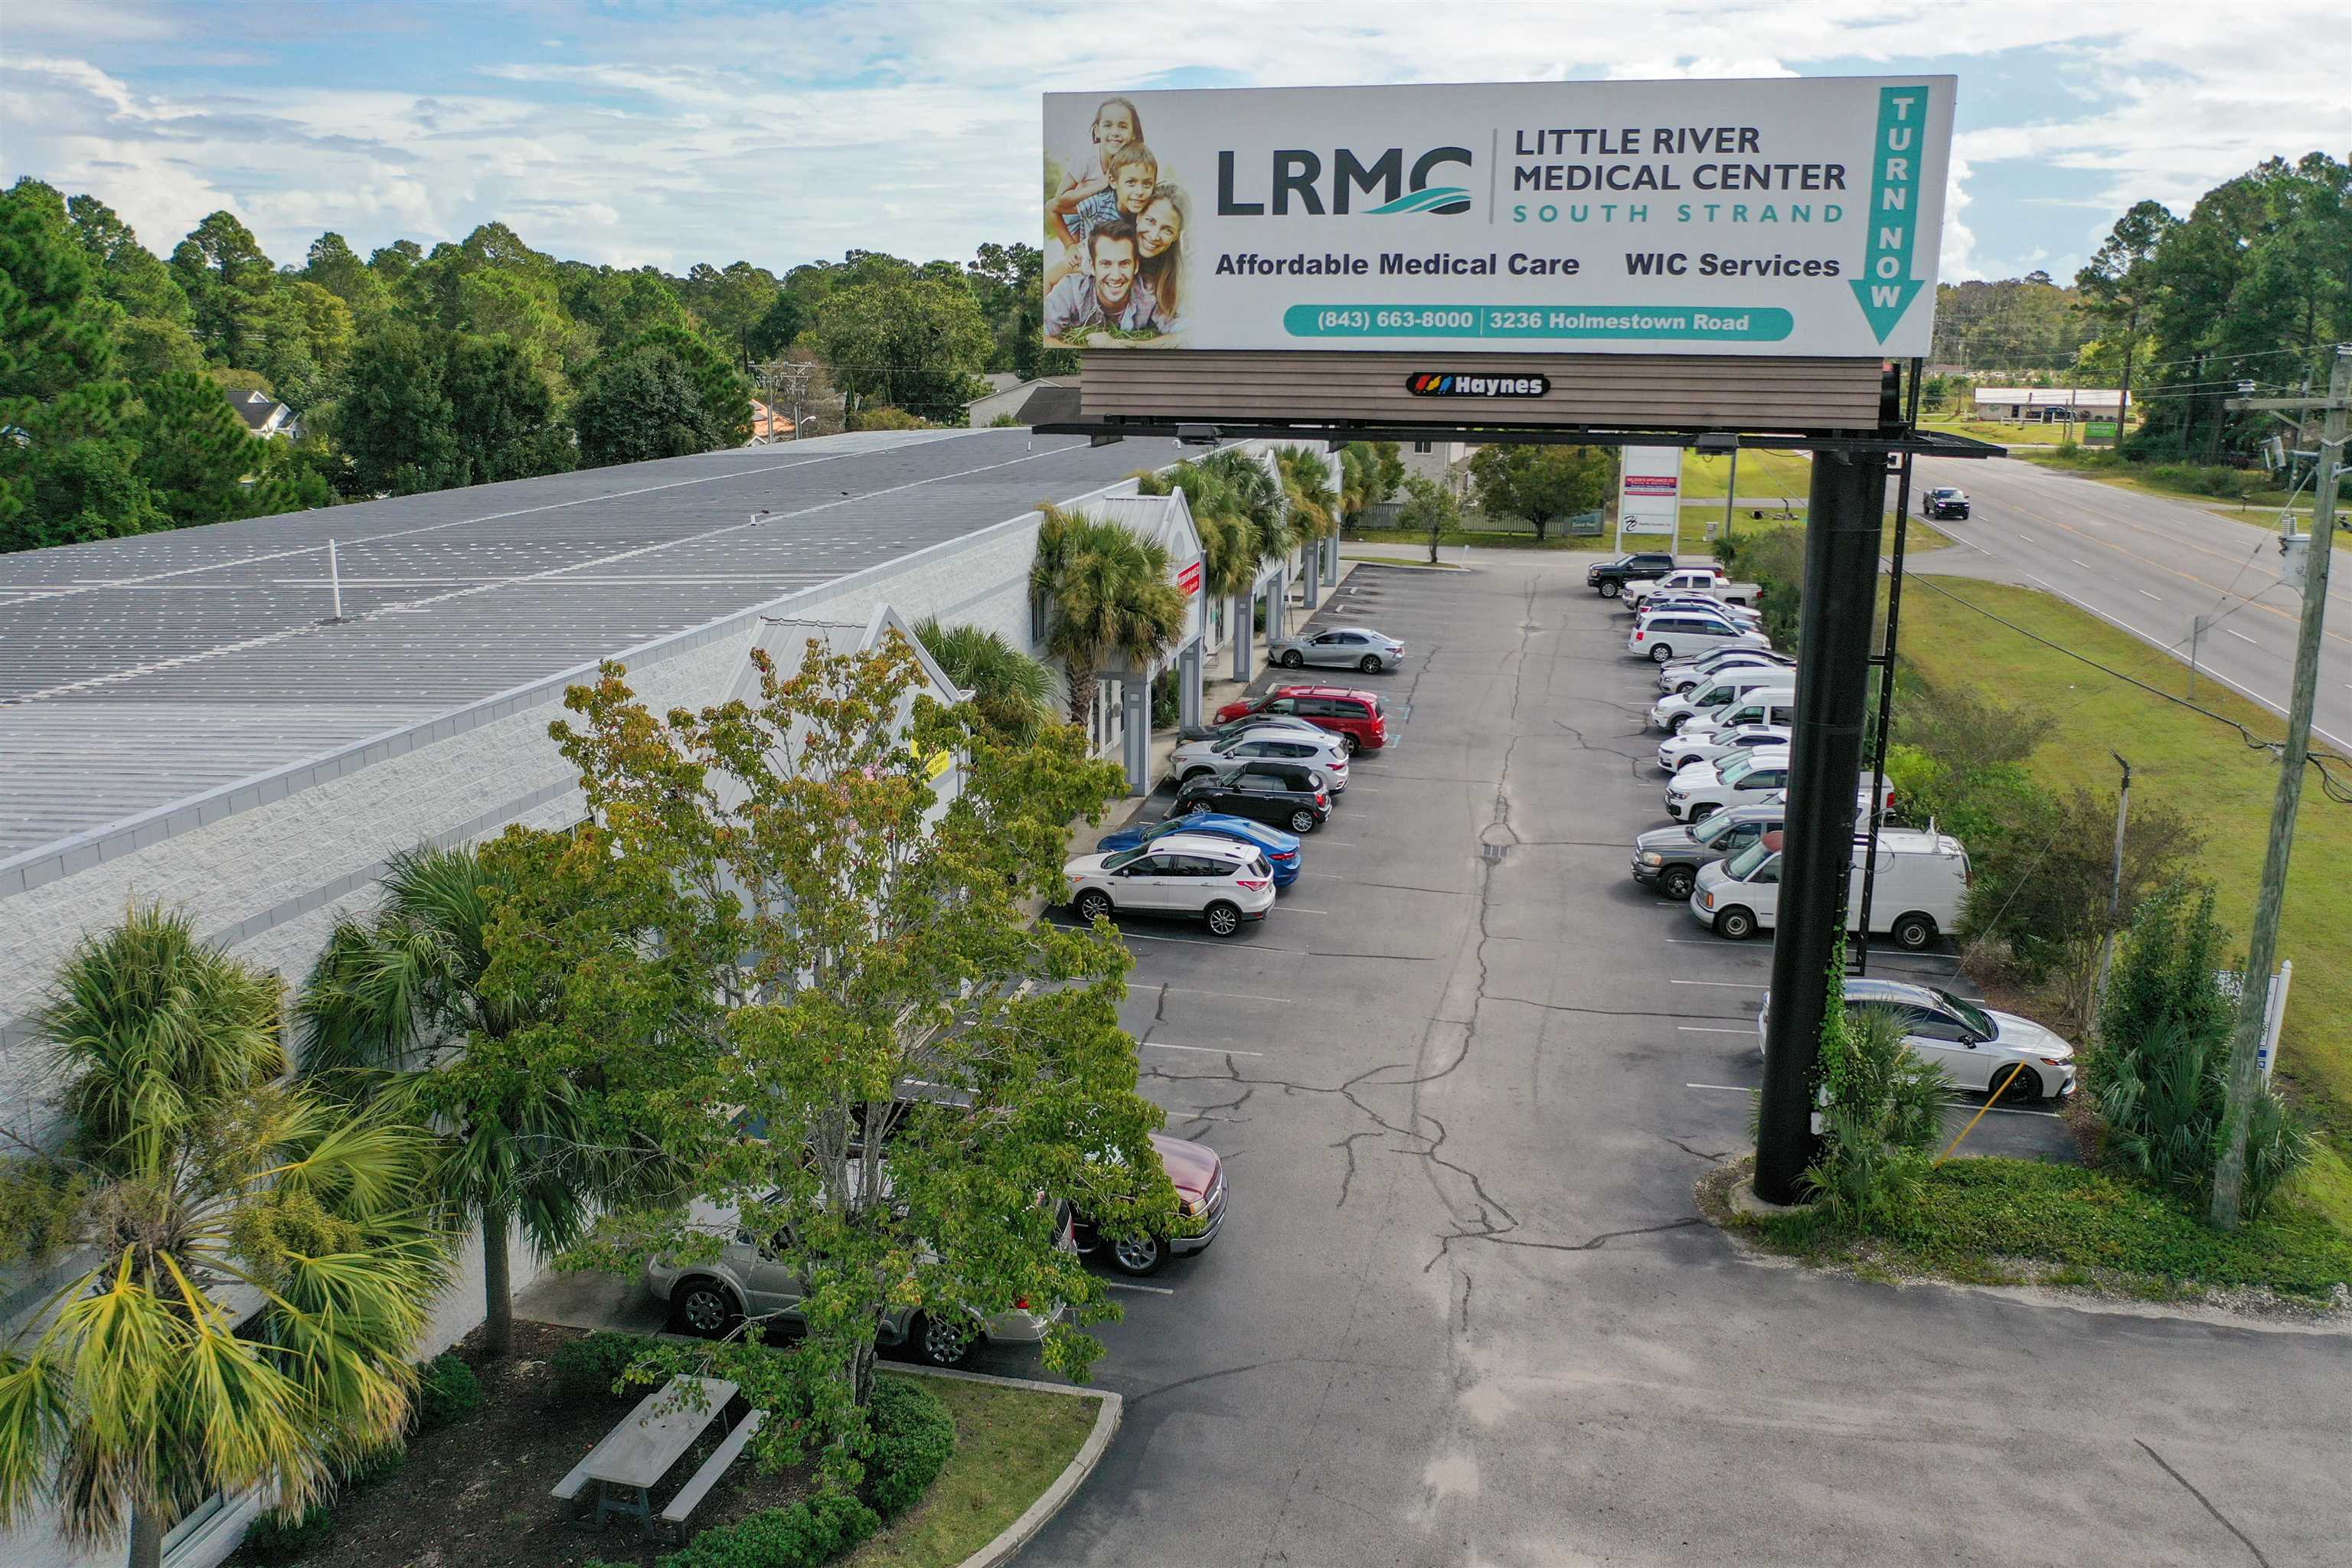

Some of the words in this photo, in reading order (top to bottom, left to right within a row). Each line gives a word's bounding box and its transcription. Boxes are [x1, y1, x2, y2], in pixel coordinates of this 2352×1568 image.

[1515, 129, 1641, 155] LITTLE
[1653, 127, 1760, 155] RIVER
[1883, 97, 1914, 211] TURN
[1217, 146, 1473, 217] LRMC
[1514, 165, 1681, 191] MEDICAL
[1692, 164, 1846, 191] CENTER
[1512, 203, 1648, 224] SOUTH
[1677, 202, 1844, 223] STRAND
[1215, 253, 1369, 276] Affordable
[1379, 253, 1497, 276] Medical
[1508, 253, 1580, 276] Care
[1625, 253, 1687, 276] WIC
[1698, 253, 1840, 276] Services
[1870, 227, 1902, 308] NOW
[1318, 312, 1370, 331] (843)
[1377, 312, 1474, 328] 663-8000
[1490, 312, 1542, 328] 3236
[1549, 312, 1685, 330] Holmestown
[1694, 313, 1749, 331] Road
[1455, 377, 1543, 396] Haynes
